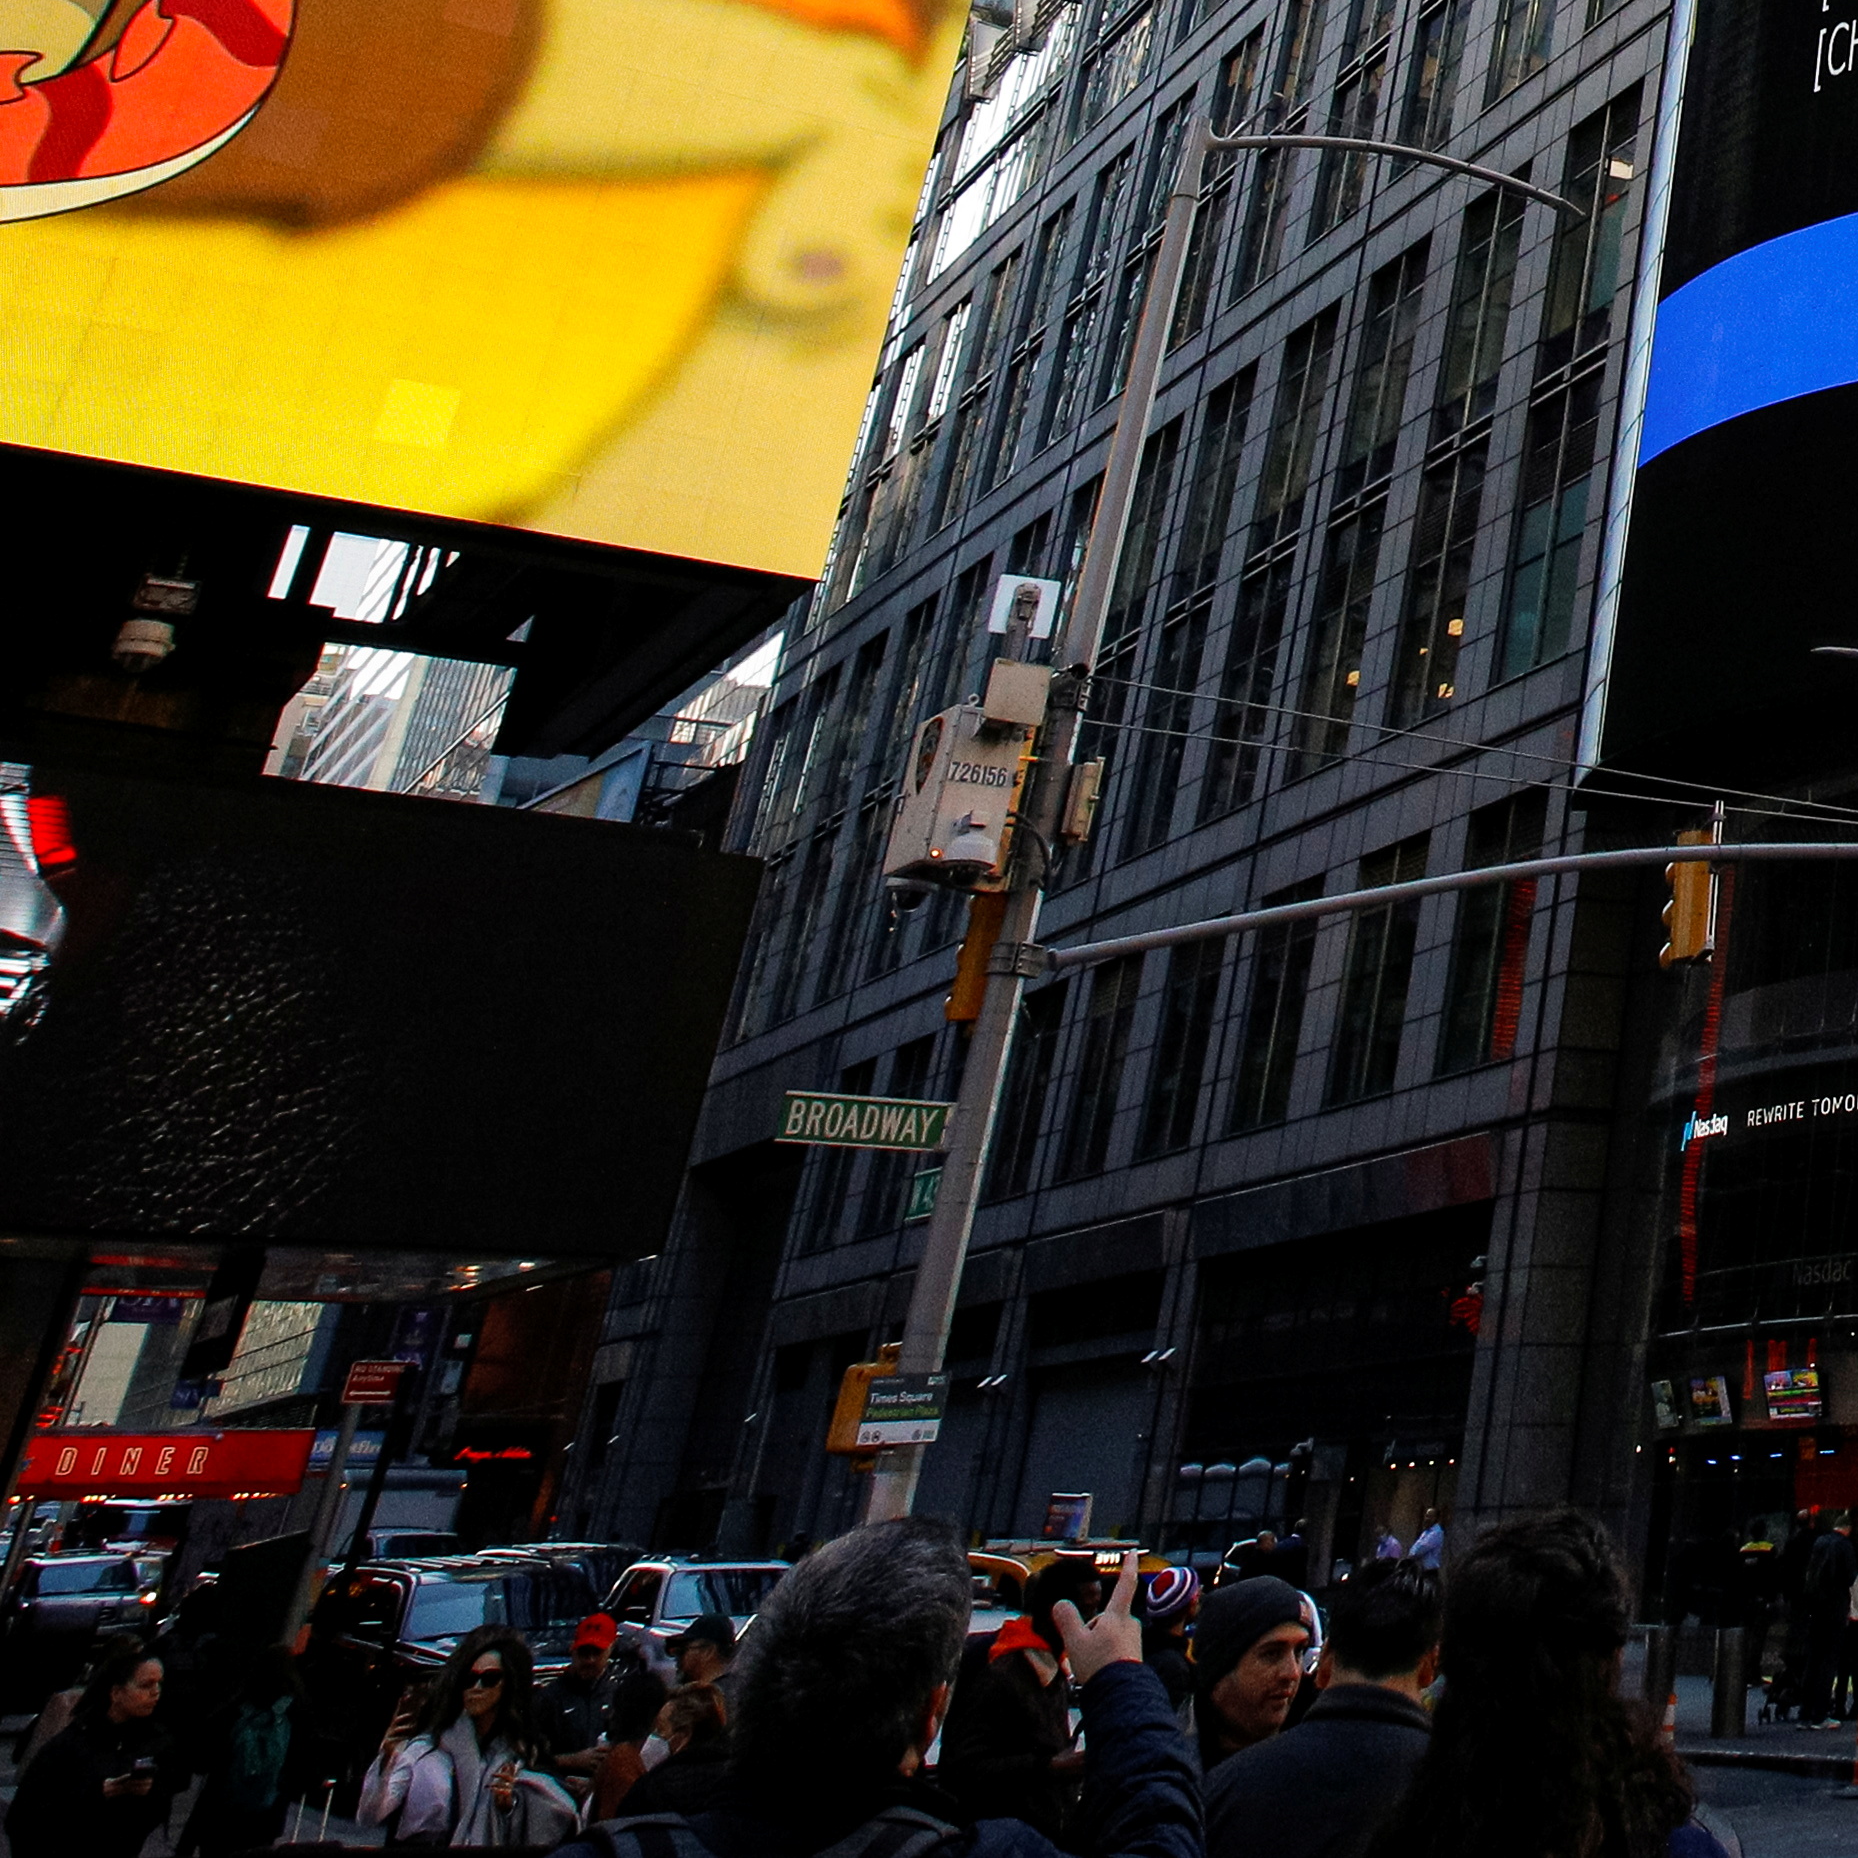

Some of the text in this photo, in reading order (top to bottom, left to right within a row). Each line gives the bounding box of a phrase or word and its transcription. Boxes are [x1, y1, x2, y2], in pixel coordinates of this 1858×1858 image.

[949, 761, 1008, 788] 726156
[784, 1099, 940, 1144] BROADWAY
[1693, 1112, 1728, 1139] Nasdaq
[1747, 1101, 1804, 1128] REWRITE
[54, 1445, 210, 1476] DINER
